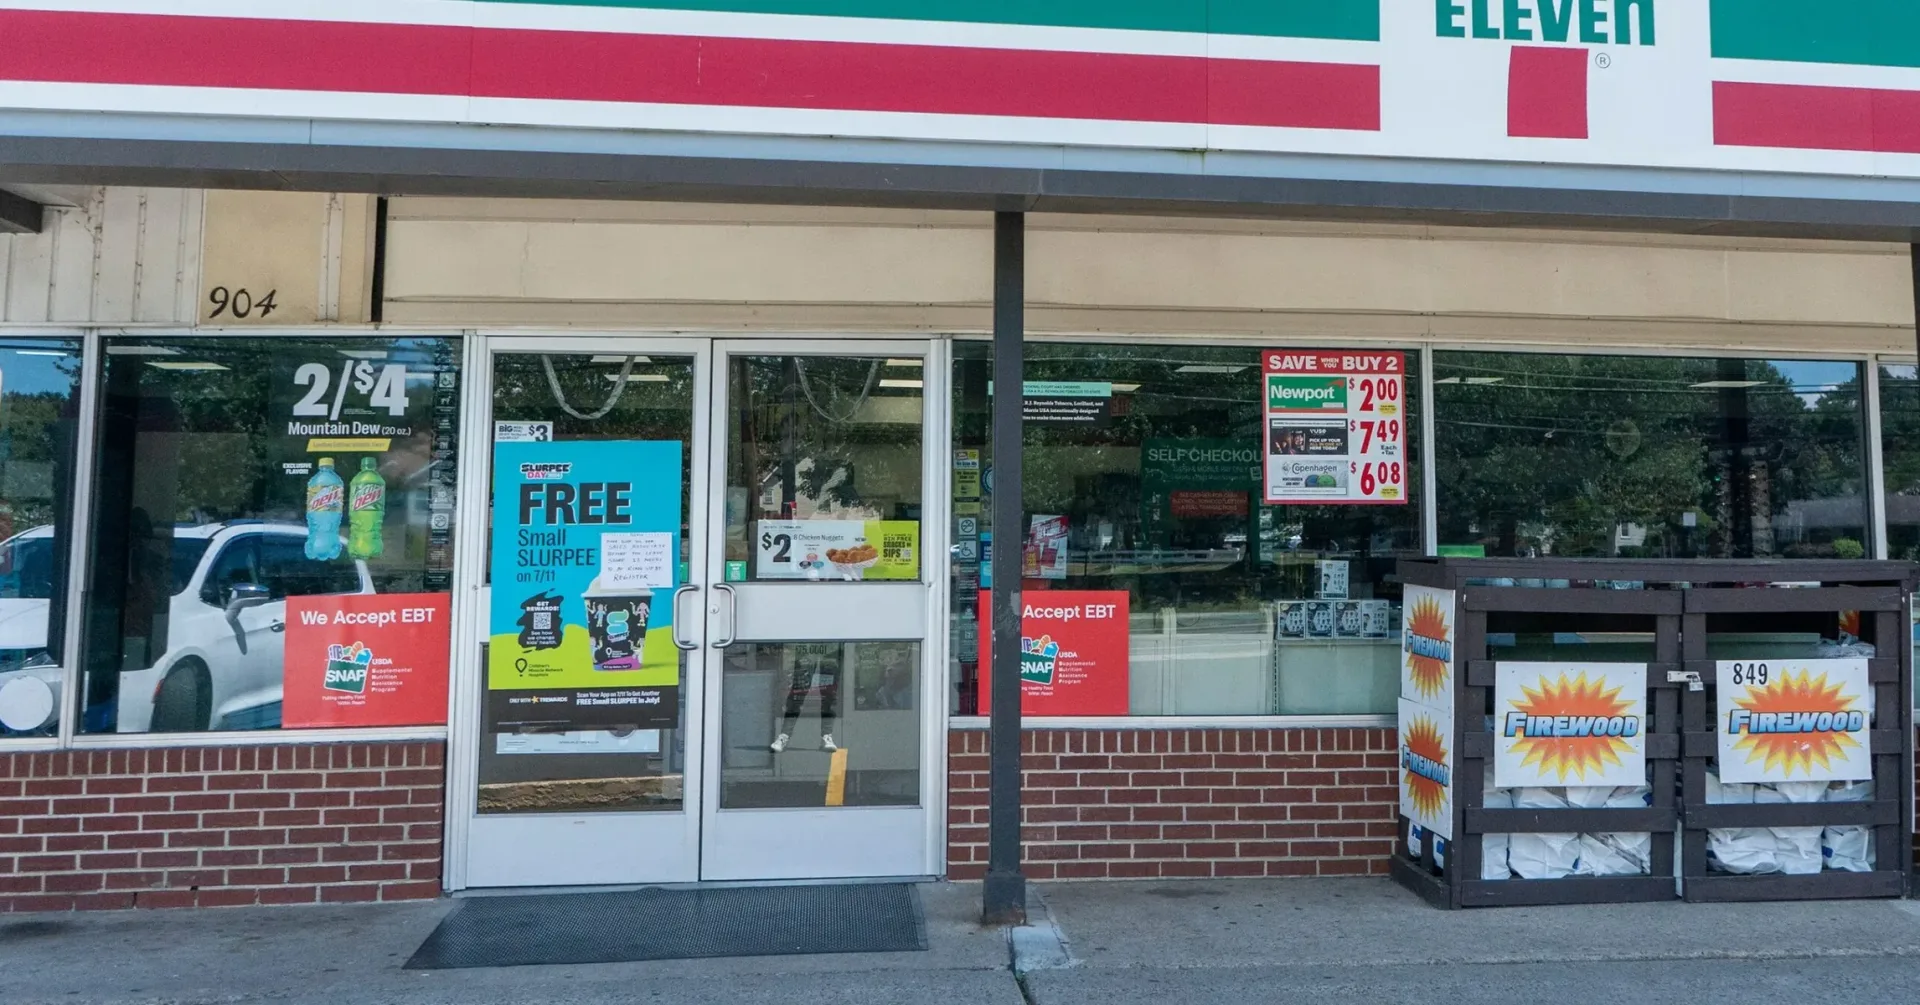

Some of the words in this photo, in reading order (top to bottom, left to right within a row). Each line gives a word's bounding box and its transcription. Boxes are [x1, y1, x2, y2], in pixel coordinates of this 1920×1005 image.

[209, 286, 278, 319] 904
[1269, 355, 1317, 370] SAVE
[1342, 356, 1382, 370] BUY
[1385, 356, 1398, 371] 2
[1271, 385, 1335, 401] Newport
[287, 421, 350, 435] Mountain
[352, 421, 382, 435] Dew
[381, 426, 396, 436] (20
[528, 424, 549, 442] $3
[1148, 449, 1185, 461] SELF
[1189, 449, 1263, 462] CHECKOU
[521, 464, 571, 473] SLURPEE
[526, 471, 547, 479] DAY
[1292, 462, 1337, 474] Copenhagen
[519, 481, 633, 526] FREE
[518, 529, 566, 546] Small
[821, 534, 844, 542] Nuggets
[761, 532, 791, 563] $2
[883, 548, 901, 558] SIPS
[517, 549, 597, 567] SLURPEE
[516, 573, 532, 583] on
[534, 570, 556, 583] 7/11
[613, 573, 648, 582] REGISTER
[301, 611, 328, 625] We
[333, 610, 397, 627] Accept
[402, 608, 436, 623] EBT
[1022, 604, 1081, 622] Accept
[1085, 604, 1116, 619] EBT
[1404, 627, 1451, 663] FIREWOOD
[327, 668, 368, 683] SNAP
[1733, 662, 1768, 685] 849
[610, 697, 637, 705] SLURPEE
[645, 697, 660, 705] July!
[1505, 711, 1639, 738] FIREWOOD
[1729, 708, 1863, 735] FIREWOOD
[1402, 744, 1450, 788] FIREWOOD
